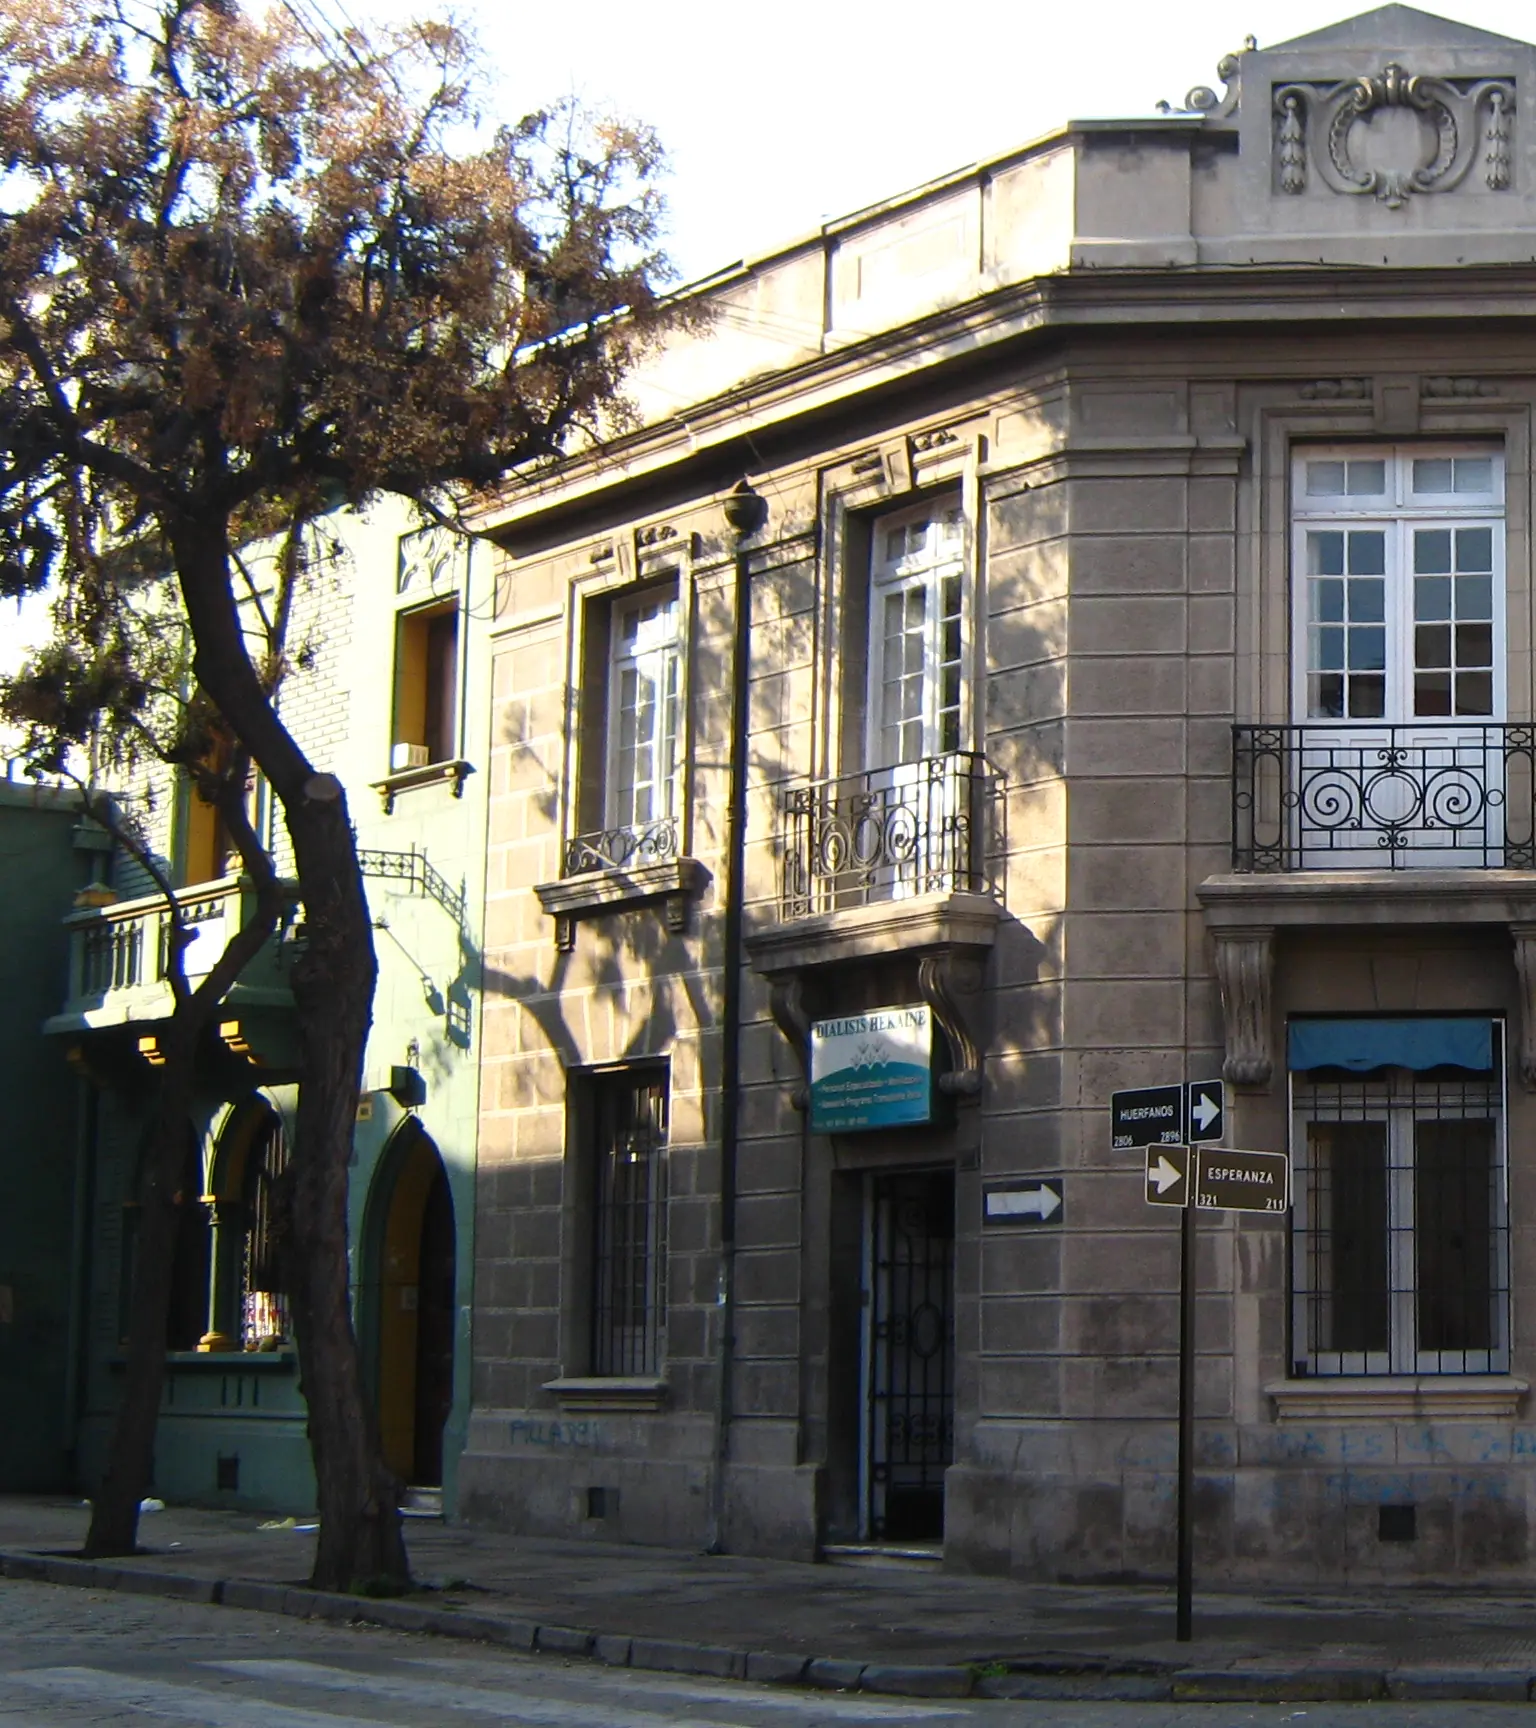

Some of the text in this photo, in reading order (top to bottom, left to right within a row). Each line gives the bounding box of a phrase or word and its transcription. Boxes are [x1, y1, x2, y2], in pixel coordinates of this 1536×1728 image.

[816, 1017, 867, 1038] DIALISIS
[1120, 1105, 1174, 1121] HUERFANOS
[1207, 1167, 1274, 1184] ESPERANZA
[1200, 1194, 1217, 1206] 321
[1266, 1198, 1283, 1210] 211
